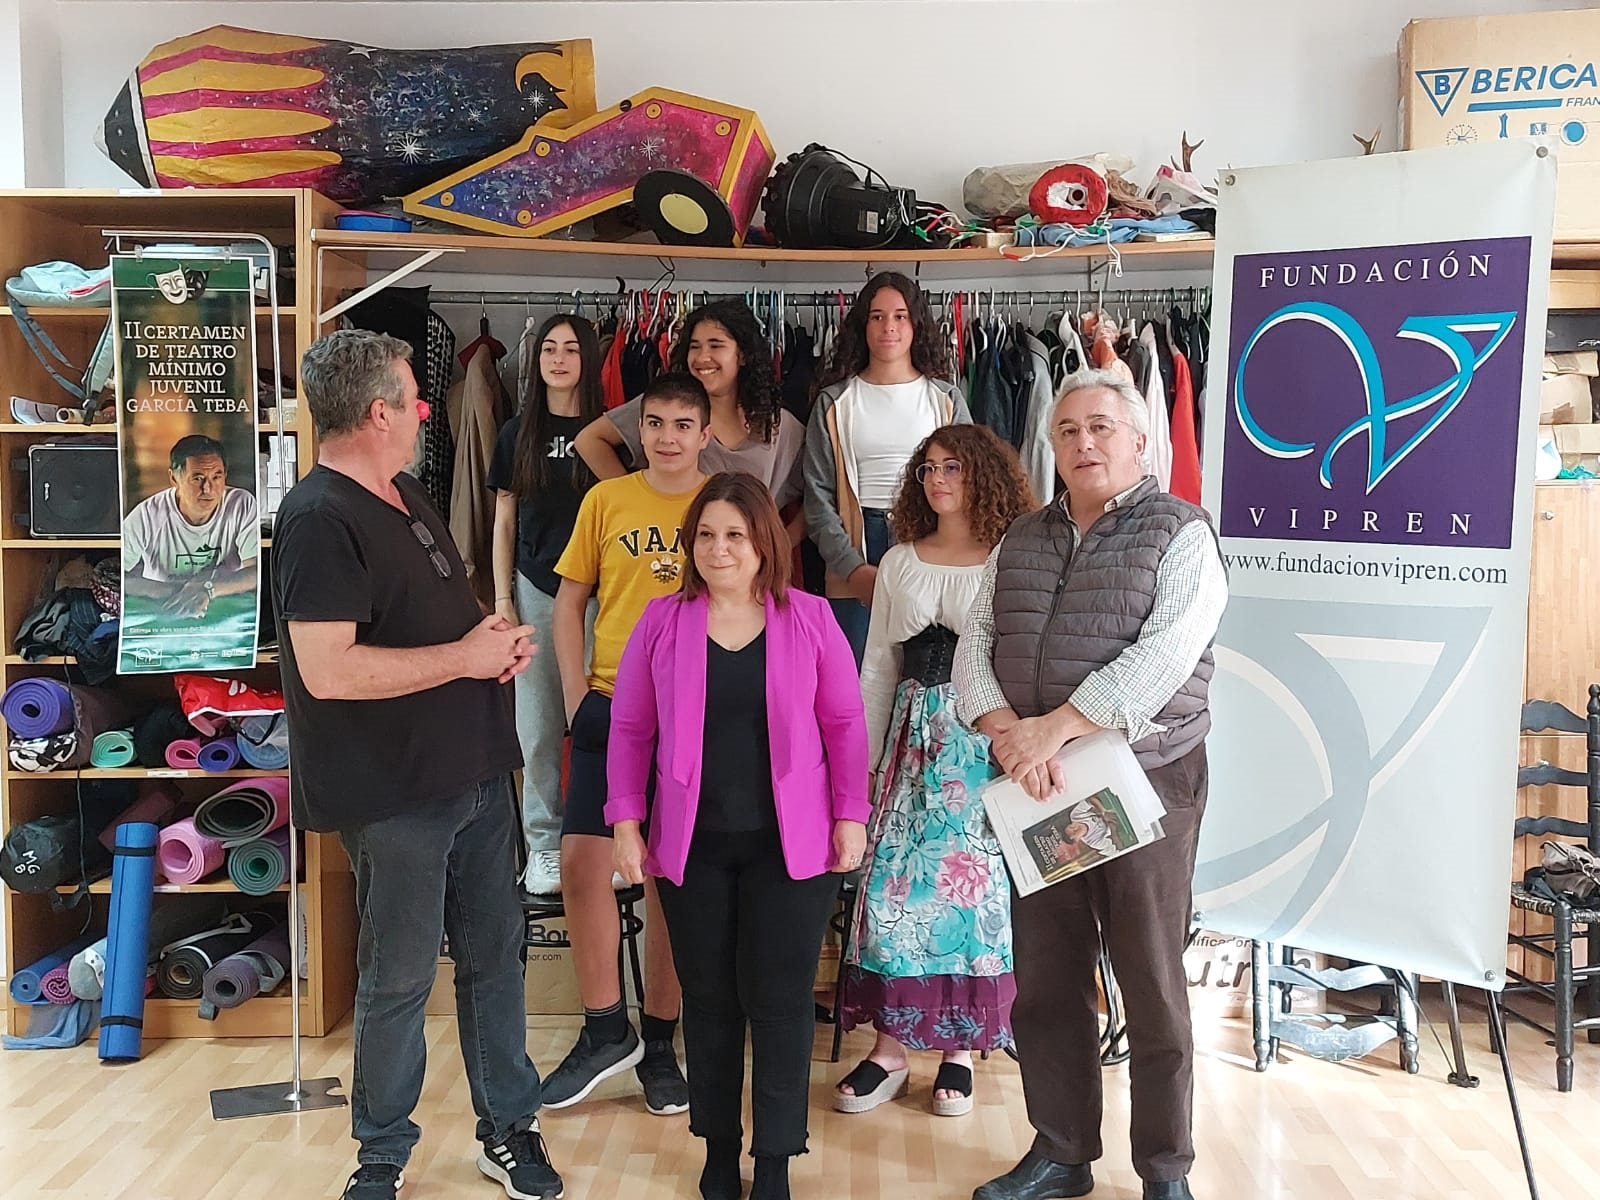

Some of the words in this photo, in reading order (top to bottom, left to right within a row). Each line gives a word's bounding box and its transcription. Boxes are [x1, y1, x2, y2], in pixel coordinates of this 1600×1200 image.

[1434, 75, 1451, 96] B
[1471, 63, 1598, 94] BERICA
[1259, 250, 1491, 288] FUNDACIÓN
[124, 321, 141, 340] II
[144, 325, 246, 340] CERTAMEN
[136, 344, 160, 359] DE
[164, 344, 237, 359] TEATRO
[148, 358, 226, 377] MÍNIMO
[150, 380, 226, 397] JUVENIL
[126, 395, 198, 413] GARCÍA
[203, 398, 250, 413] TEBA
[1249, 507, 1472, 536] VIPREN
